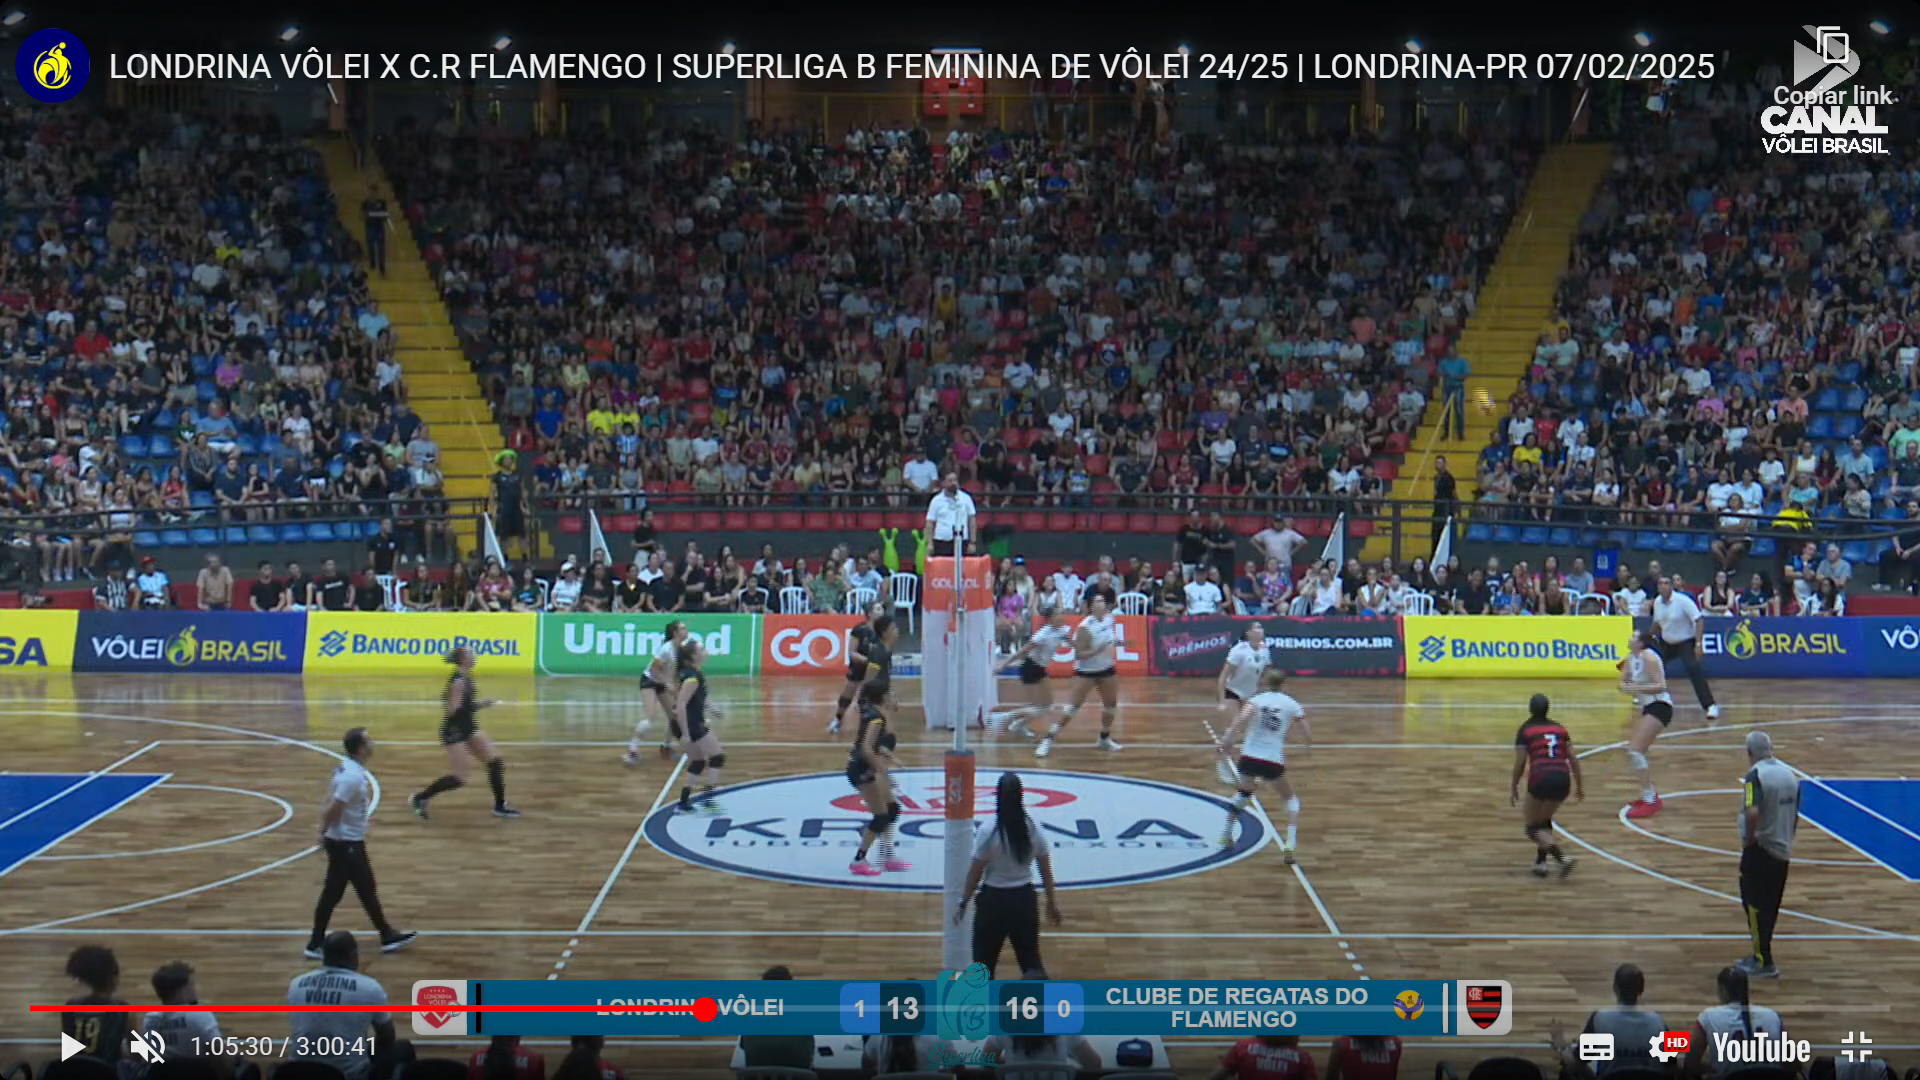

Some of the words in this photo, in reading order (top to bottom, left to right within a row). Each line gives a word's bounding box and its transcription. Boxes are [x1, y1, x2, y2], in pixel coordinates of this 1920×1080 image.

[91, 633, 164, 660] VÔLEI
[200, 639, 287, 662] BRASIL
[352, 633, 420, 656] BANCO
[423, 637, 450, 656] DO
[453, 635, 521, 656] BRASIL
[1452, 638, 1519, 659] BANCO
[1523, 641, 1550, 659] DO
[1552, 639, 1621, 661] BRASIL
[1759, 632, 1847, 655] BRASIL
